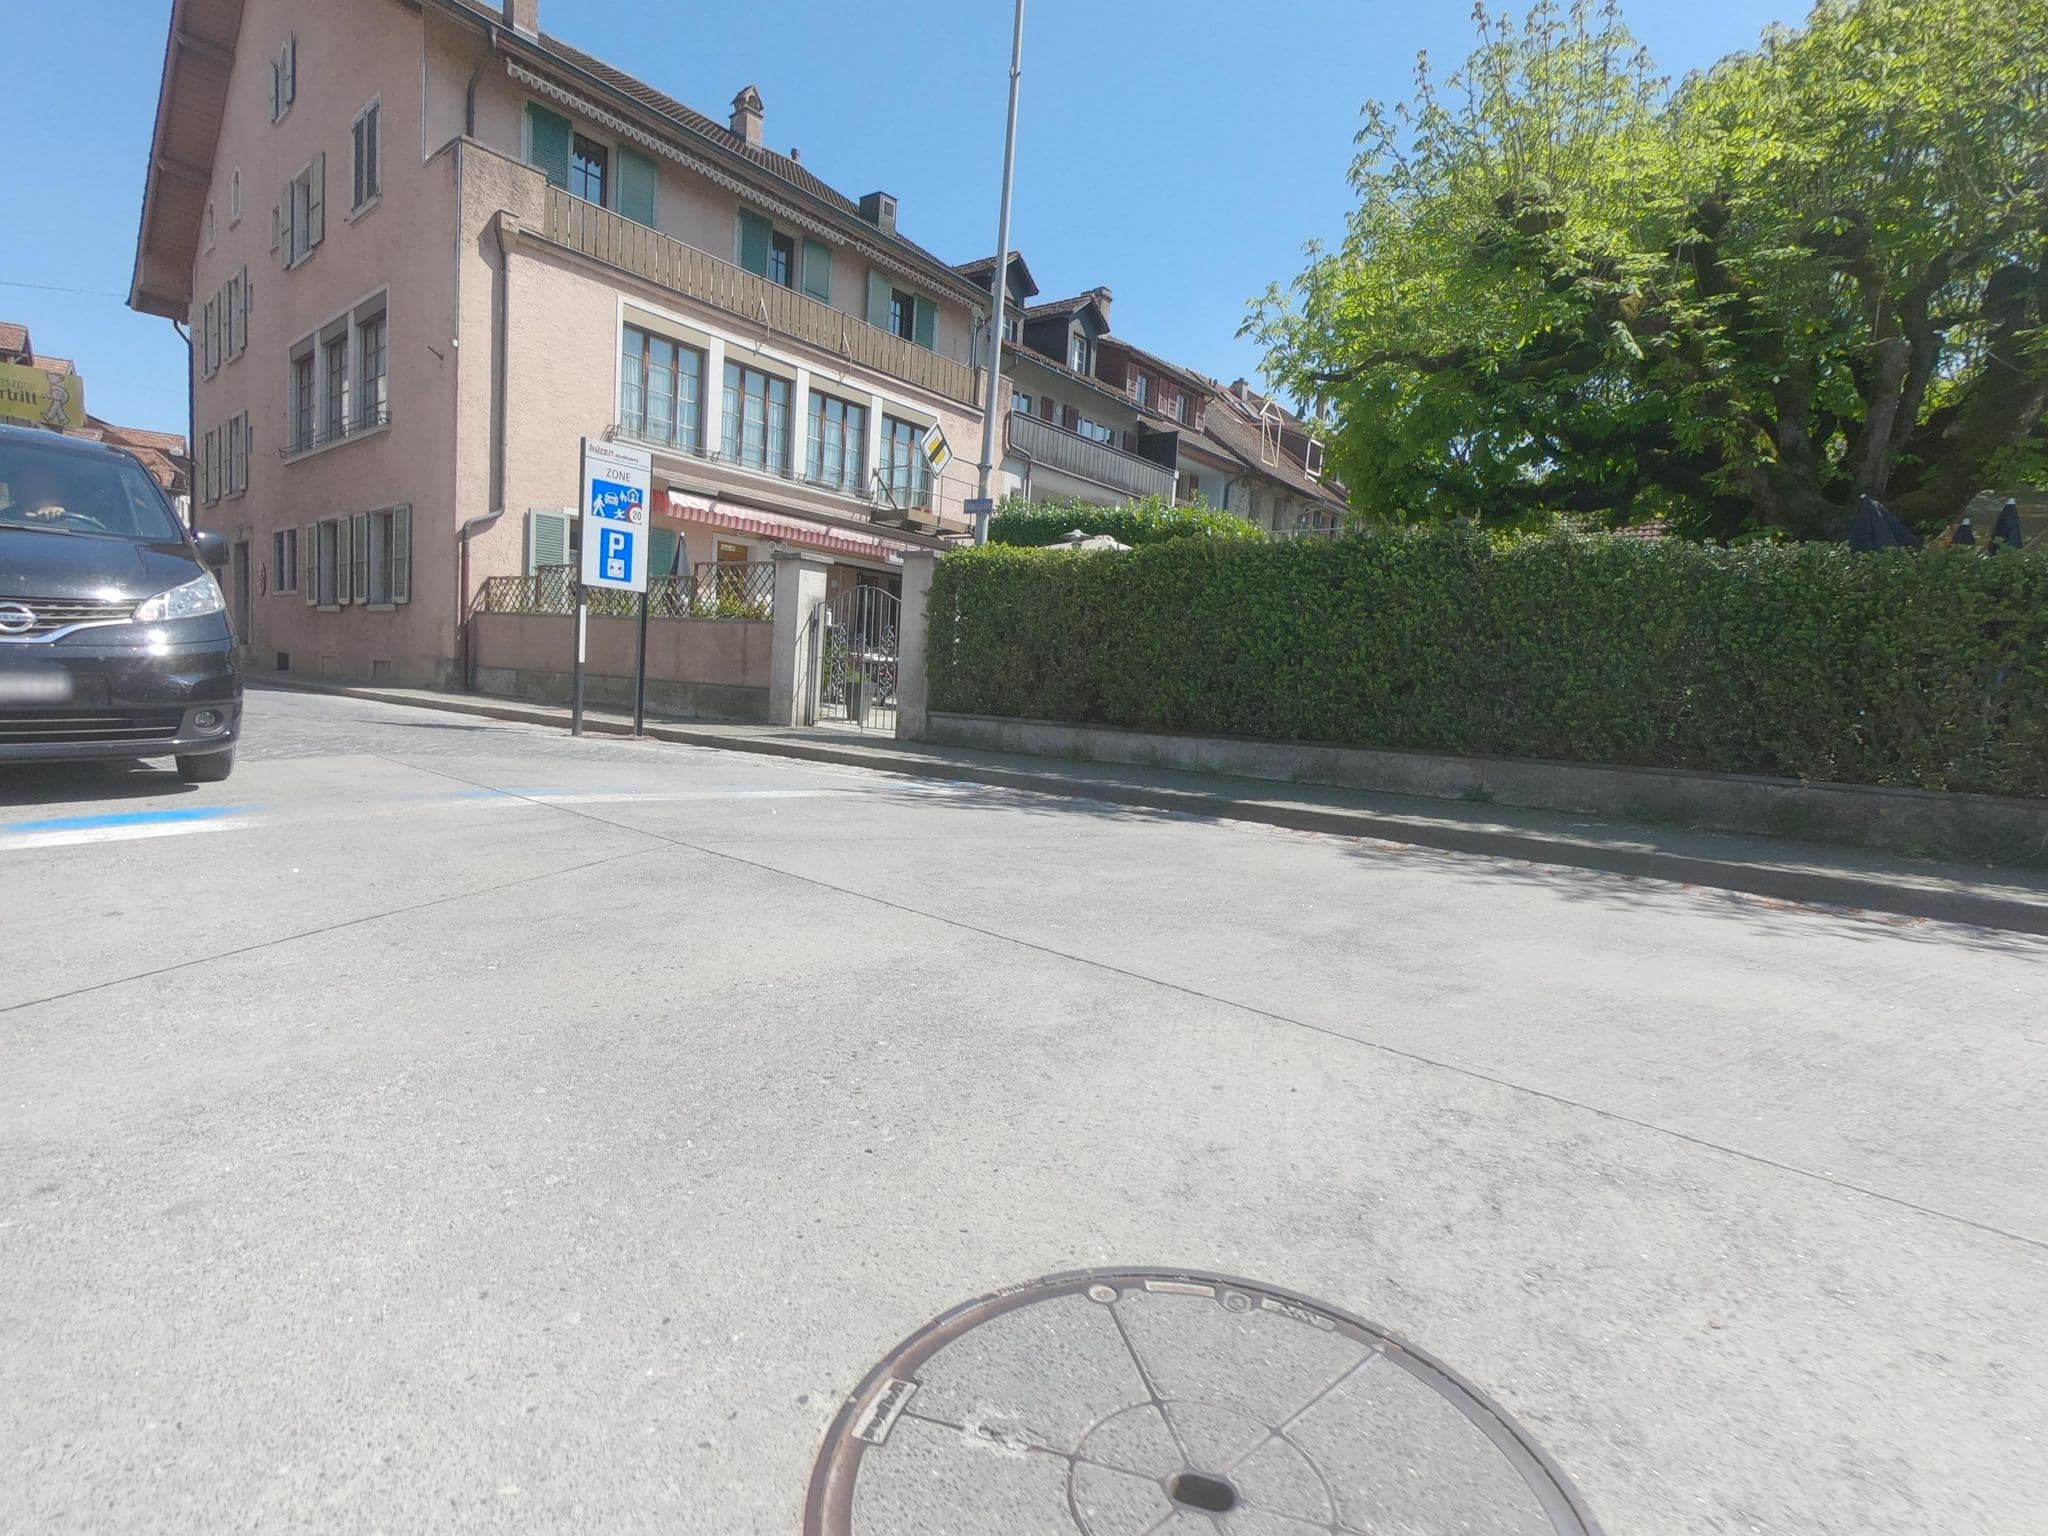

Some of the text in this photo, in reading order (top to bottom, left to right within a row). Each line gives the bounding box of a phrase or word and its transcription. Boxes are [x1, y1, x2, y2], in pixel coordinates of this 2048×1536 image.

[606, 468, 631, 482] ZONE
[632, 510, 642, 520] 20
[609, 532, 625, 558] P
